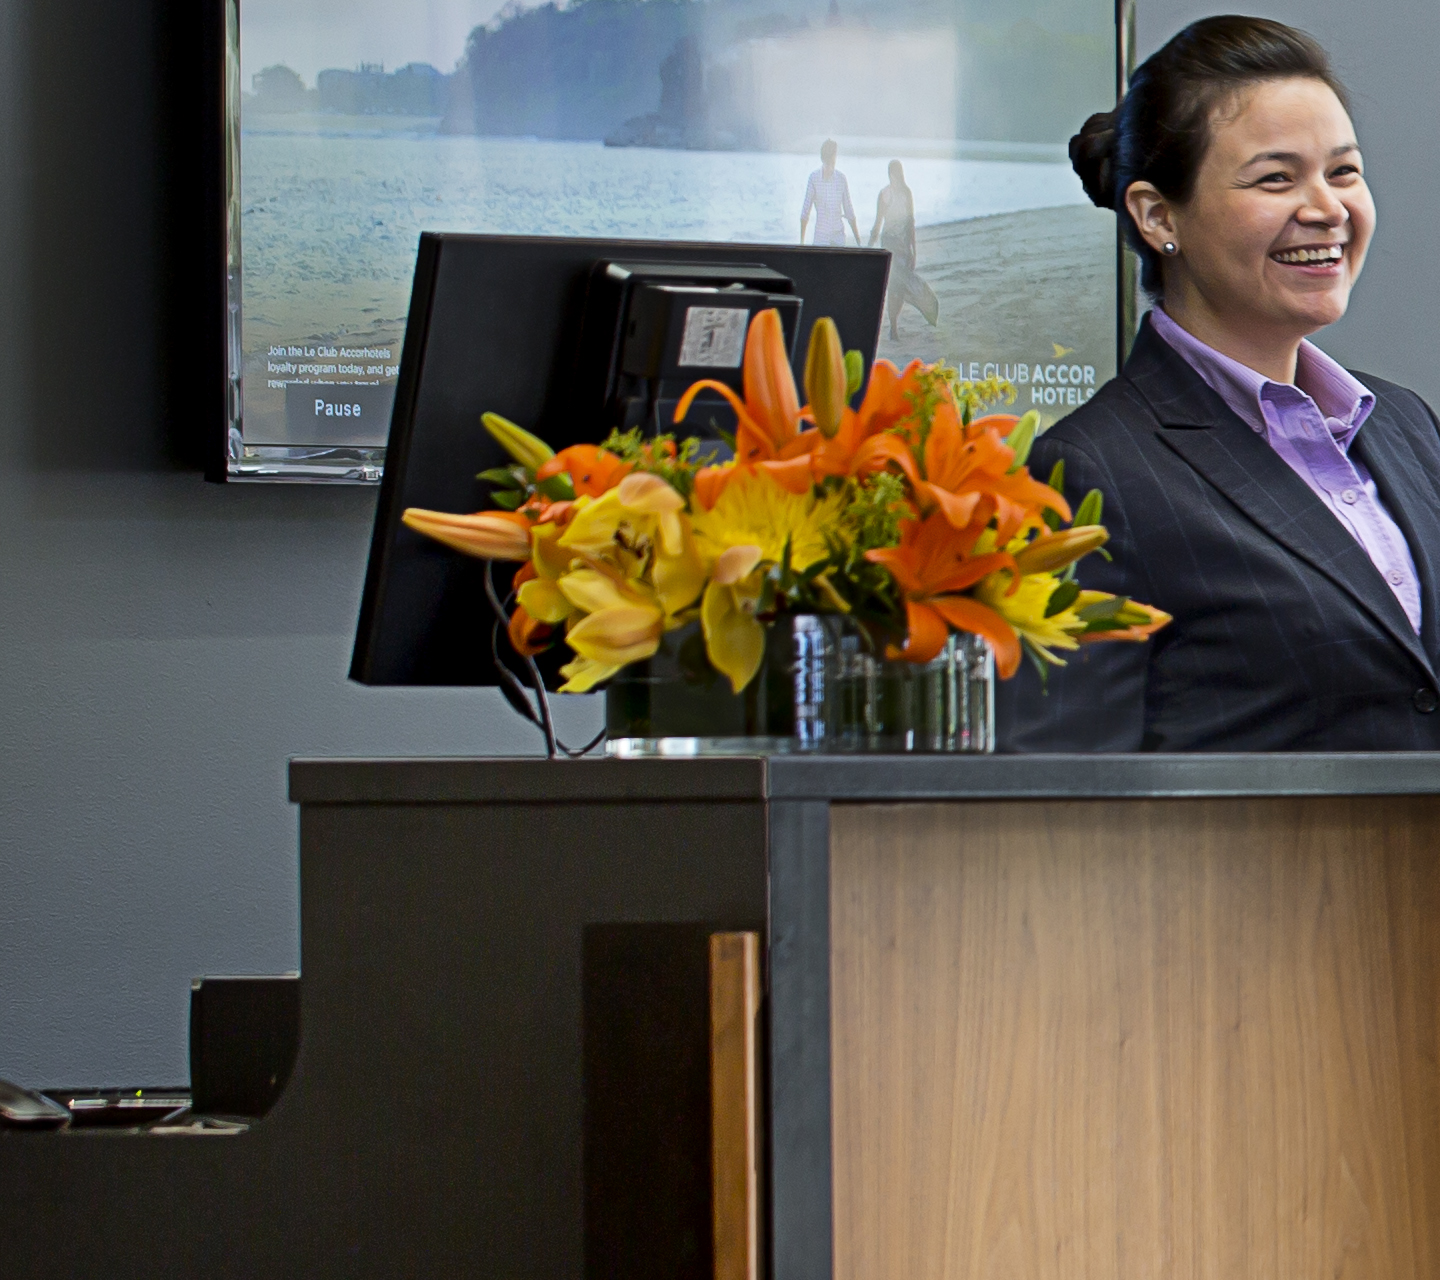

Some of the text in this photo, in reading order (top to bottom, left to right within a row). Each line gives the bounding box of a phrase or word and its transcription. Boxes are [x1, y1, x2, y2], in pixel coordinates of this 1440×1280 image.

[268, 346, 391, 359] Join the Le Club Accorhotels
[268, 361, 399, 377] loyalty program today, and get
[959, 362, 980, 382] LE
[1032, 364, 1096, 385] ACCOR
[315, 399, 362, 417] Pause
